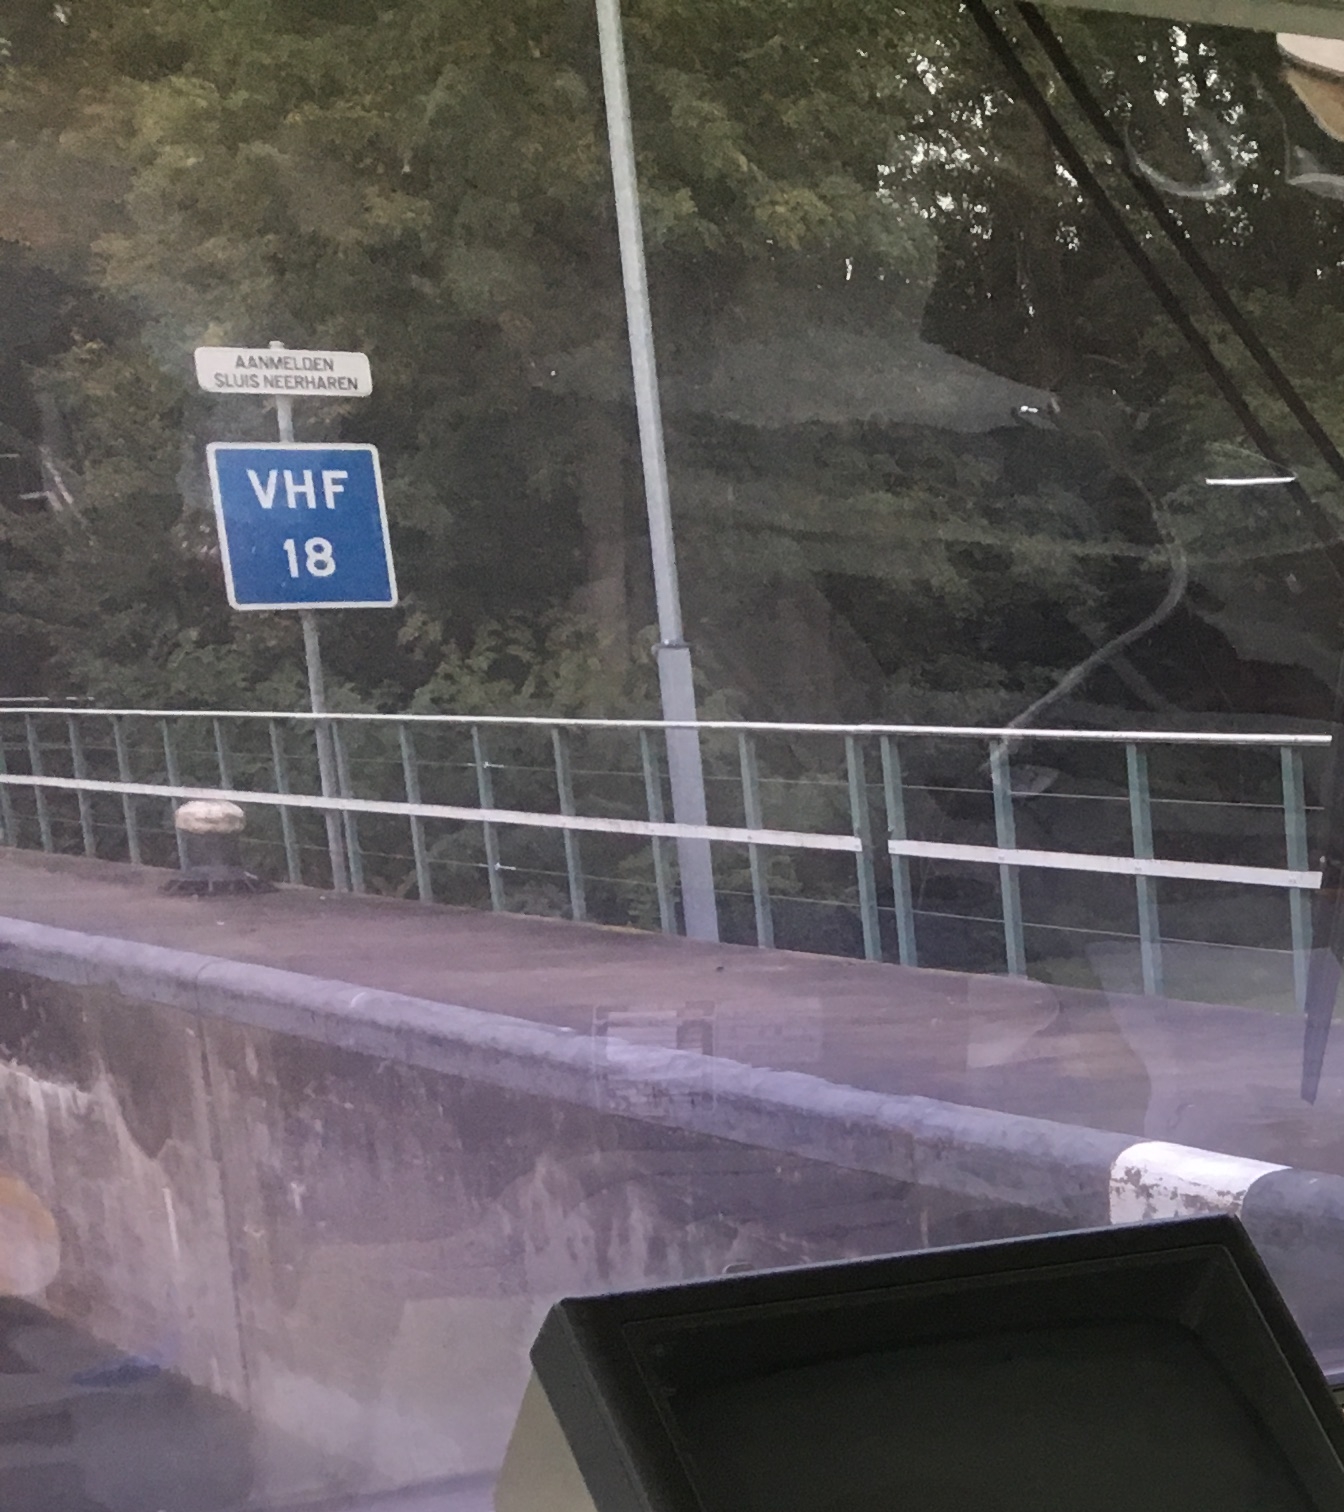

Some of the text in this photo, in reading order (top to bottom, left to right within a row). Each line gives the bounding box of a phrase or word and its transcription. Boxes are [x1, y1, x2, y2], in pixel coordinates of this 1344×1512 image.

[235, 355, 334, 372] AANMELDEN
[214, 372, 358, 391] SLUIS NEERHAREN
[246, 469, 348, 510] VHF
[283, 537, 336, 578] 18
